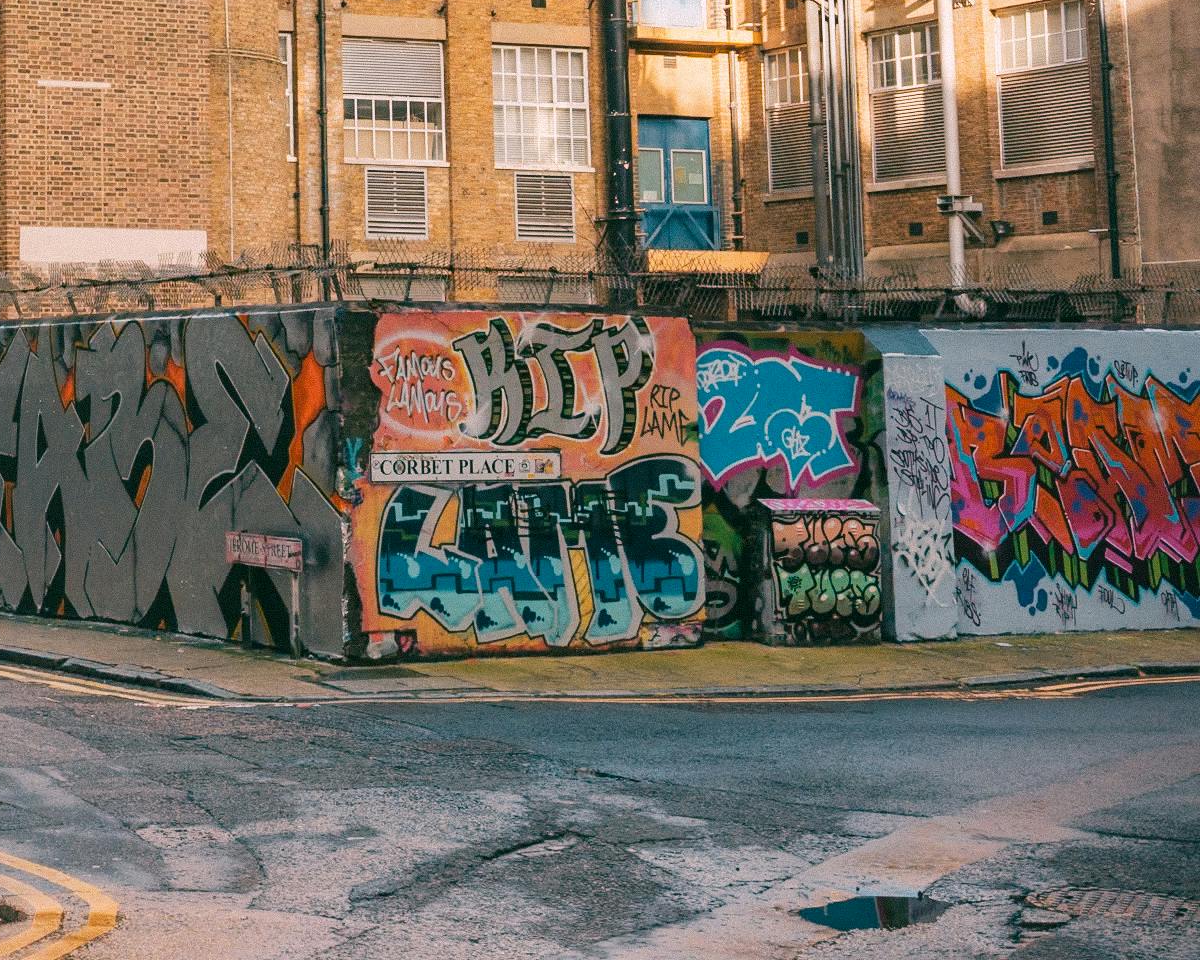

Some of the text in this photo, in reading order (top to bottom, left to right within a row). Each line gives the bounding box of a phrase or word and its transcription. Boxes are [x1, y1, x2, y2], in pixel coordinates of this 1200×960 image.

[650, 383, 681, 414] RIP
[379, 458, 516, 476] CORBET PLACE
